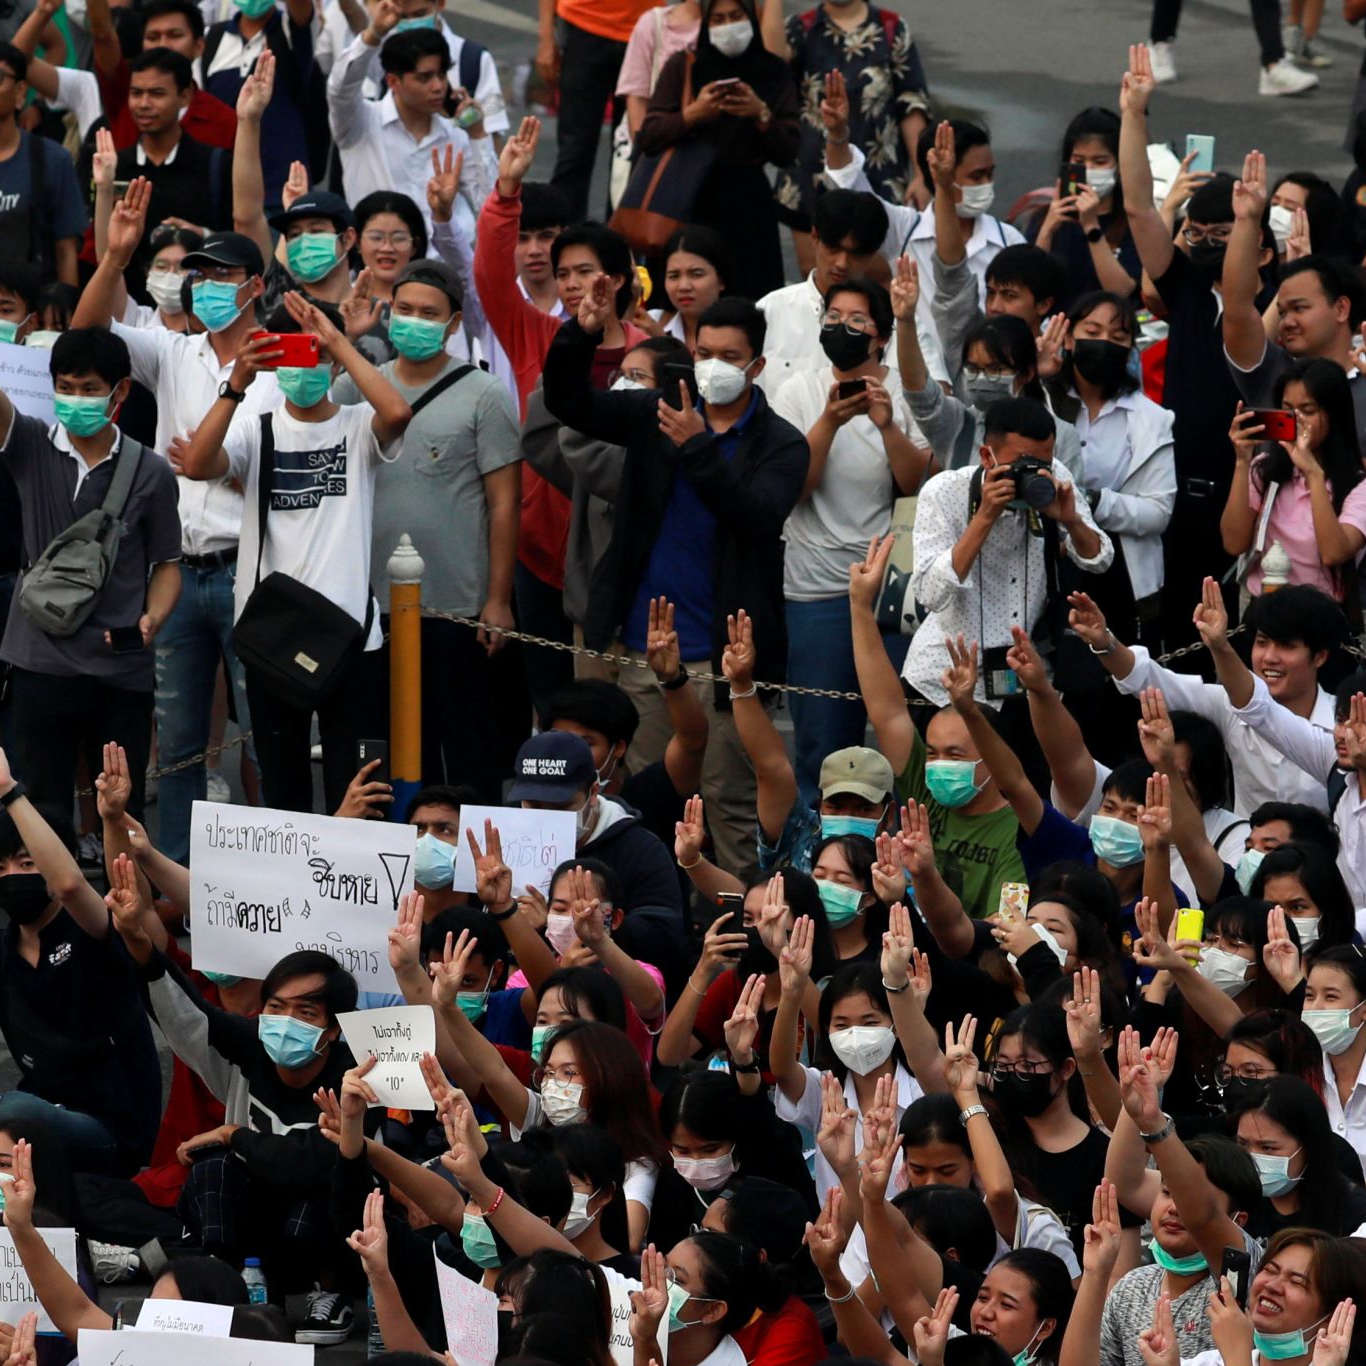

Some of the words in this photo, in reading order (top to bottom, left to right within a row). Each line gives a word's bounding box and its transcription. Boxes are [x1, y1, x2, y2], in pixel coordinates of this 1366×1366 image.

[522, 758, 537, 767] ONE
[538, 758, 567, 768] HEART
[522, 766, 537, 775] ONE
[537, 767, 566, 776] GOAL
[204, 813, 321, 856] ประเทศชาติจะ
